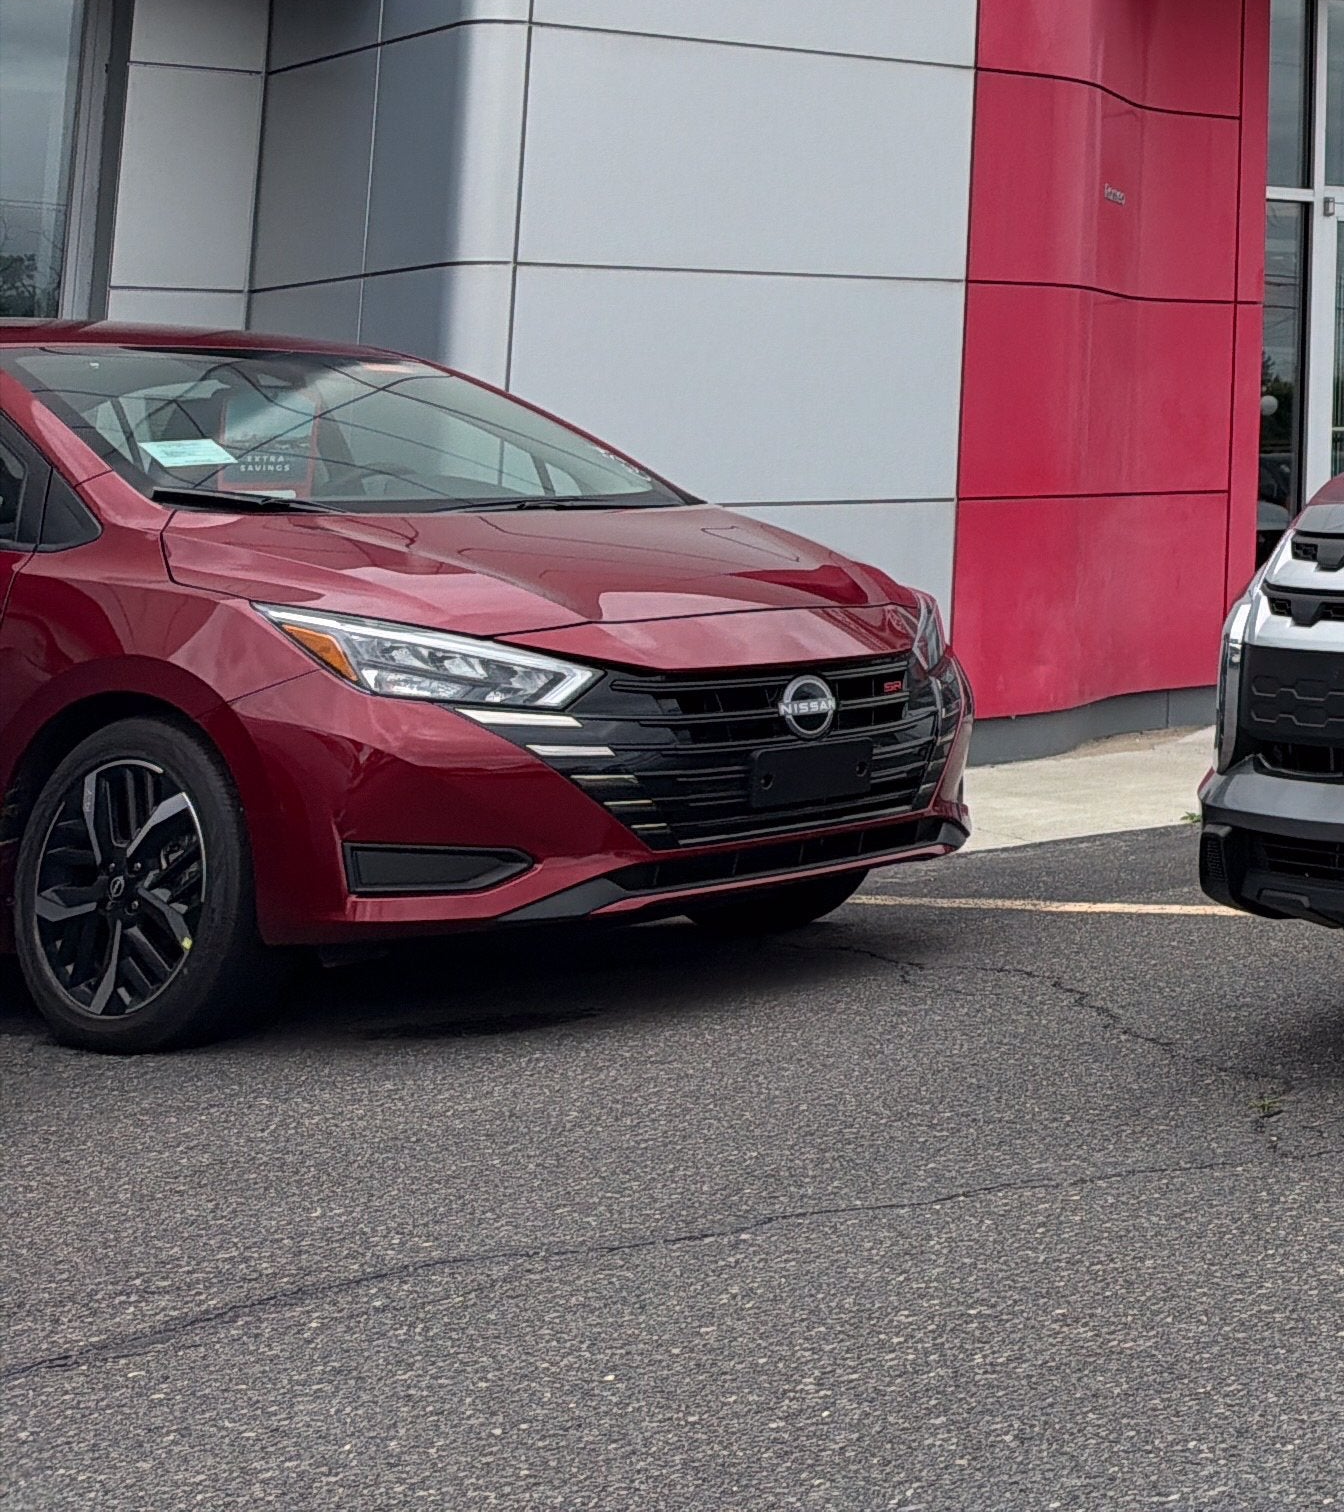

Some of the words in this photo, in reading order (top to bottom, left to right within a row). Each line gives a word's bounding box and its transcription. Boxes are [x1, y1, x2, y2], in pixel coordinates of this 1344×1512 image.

[247, 455, 286, 463] EXTRA
[240, 464, 291, 472] SAVINGS
[779, 699, 836, 716] NISSAN
